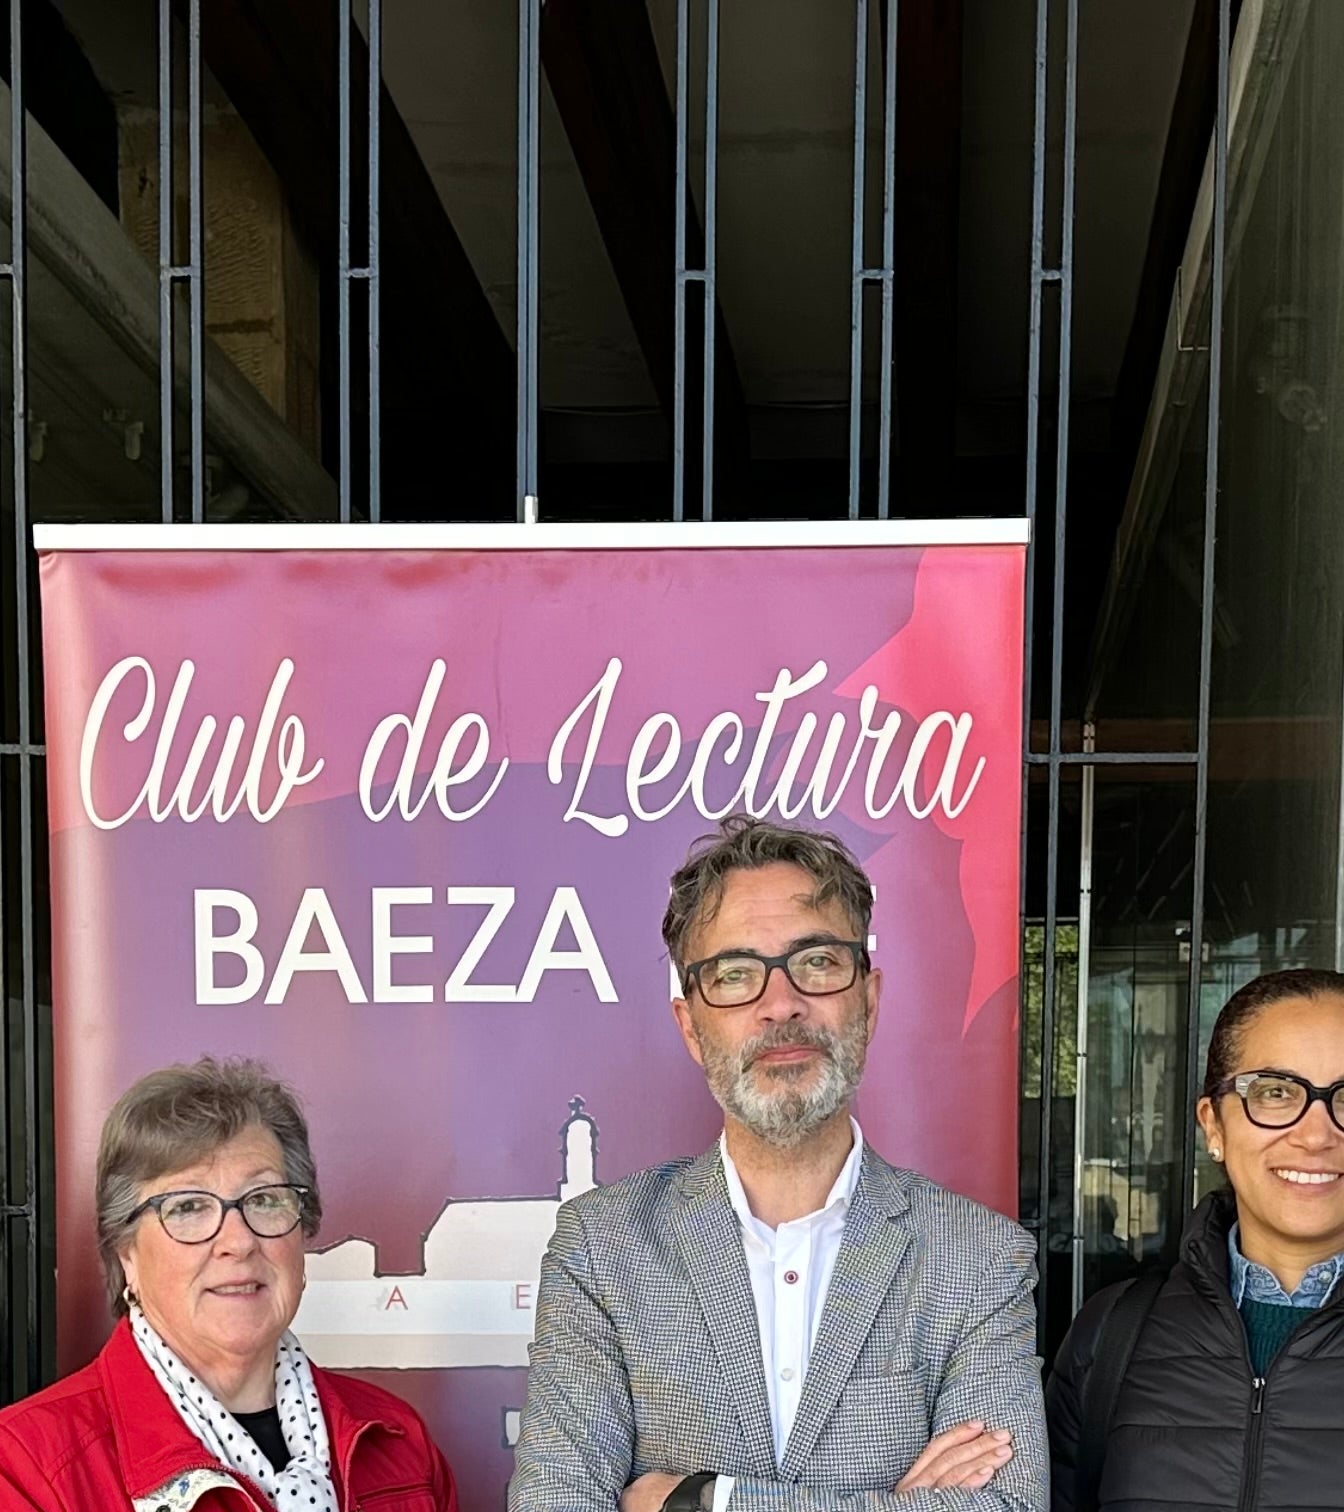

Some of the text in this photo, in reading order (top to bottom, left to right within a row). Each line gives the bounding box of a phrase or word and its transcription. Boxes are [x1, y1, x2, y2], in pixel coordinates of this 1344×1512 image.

[78, 654, 989, 838] Club de Lectura
[192, 885, 620, 1005] BAEZA
